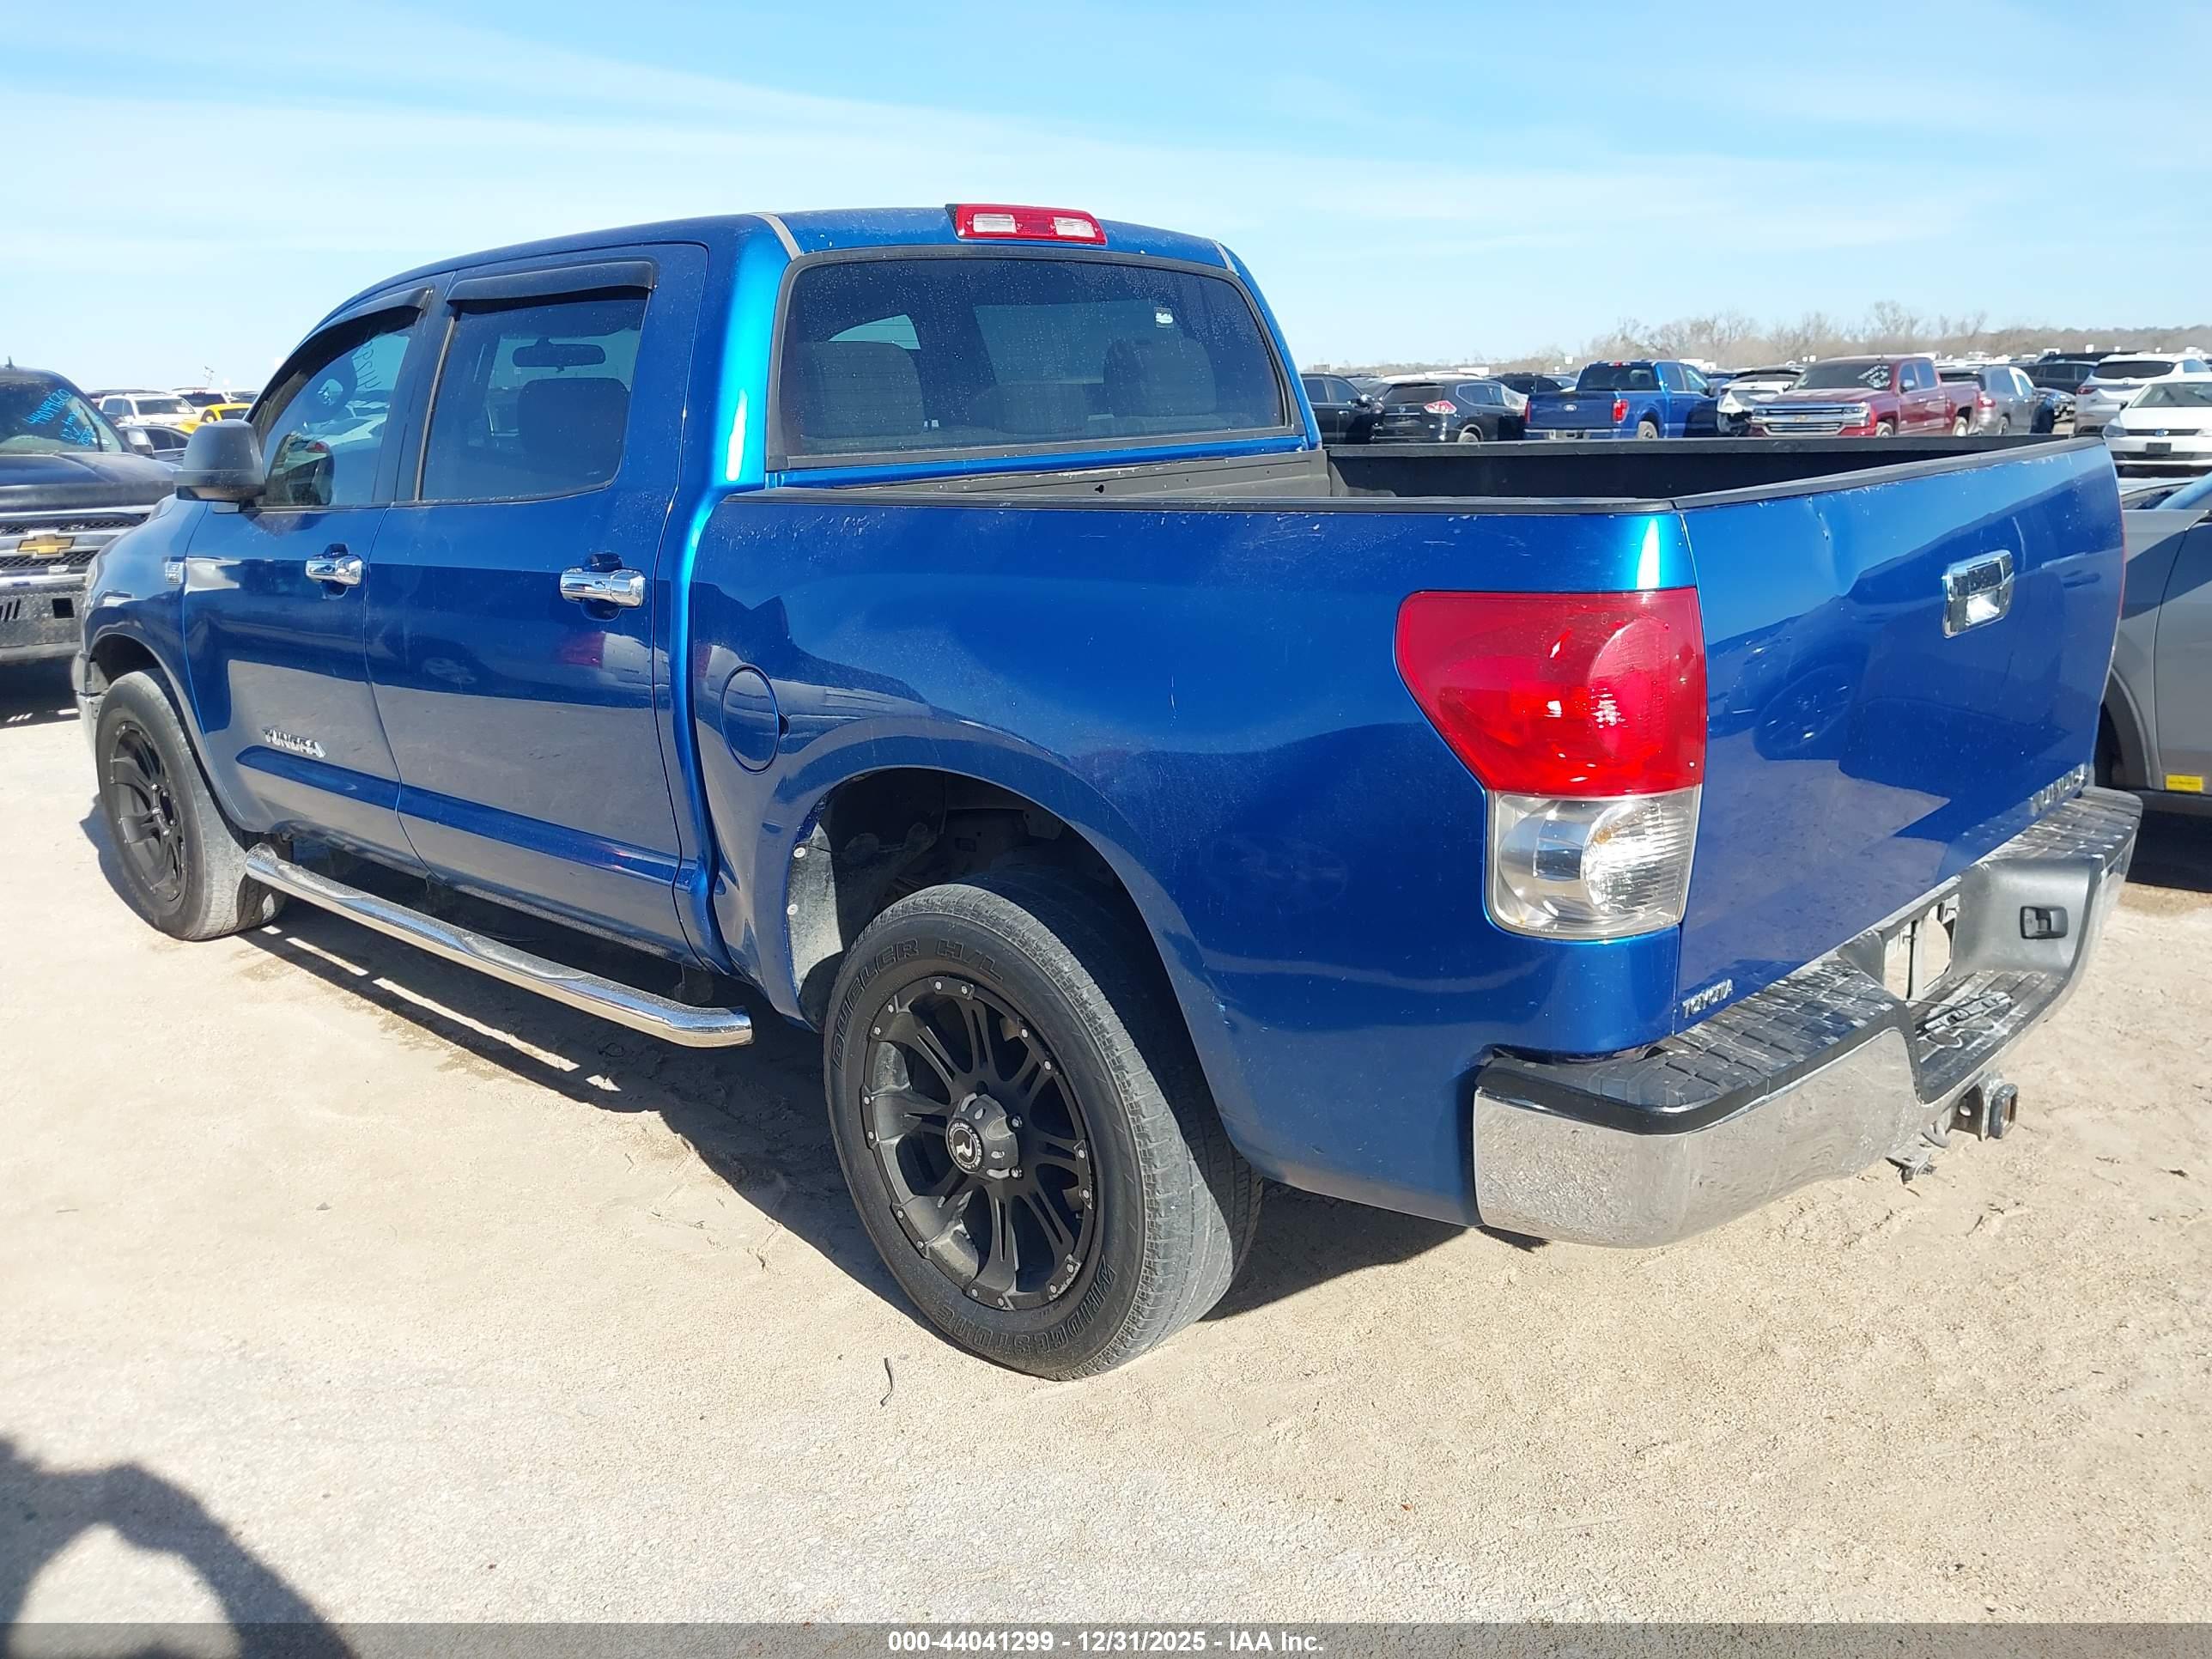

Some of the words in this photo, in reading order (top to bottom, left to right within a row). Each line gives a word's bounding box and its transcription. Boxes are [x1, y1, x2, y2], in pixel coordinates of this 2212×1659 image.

[262, 728, 326, 757] TUNDRA
[832, 938, 920, 1070] DUELER
[935, 939, 1003, 983] H/L
[1682, 978, 1735, 1019] TOYOTA
[935, 1254, 1117, 1355] BRIDGESTONE
